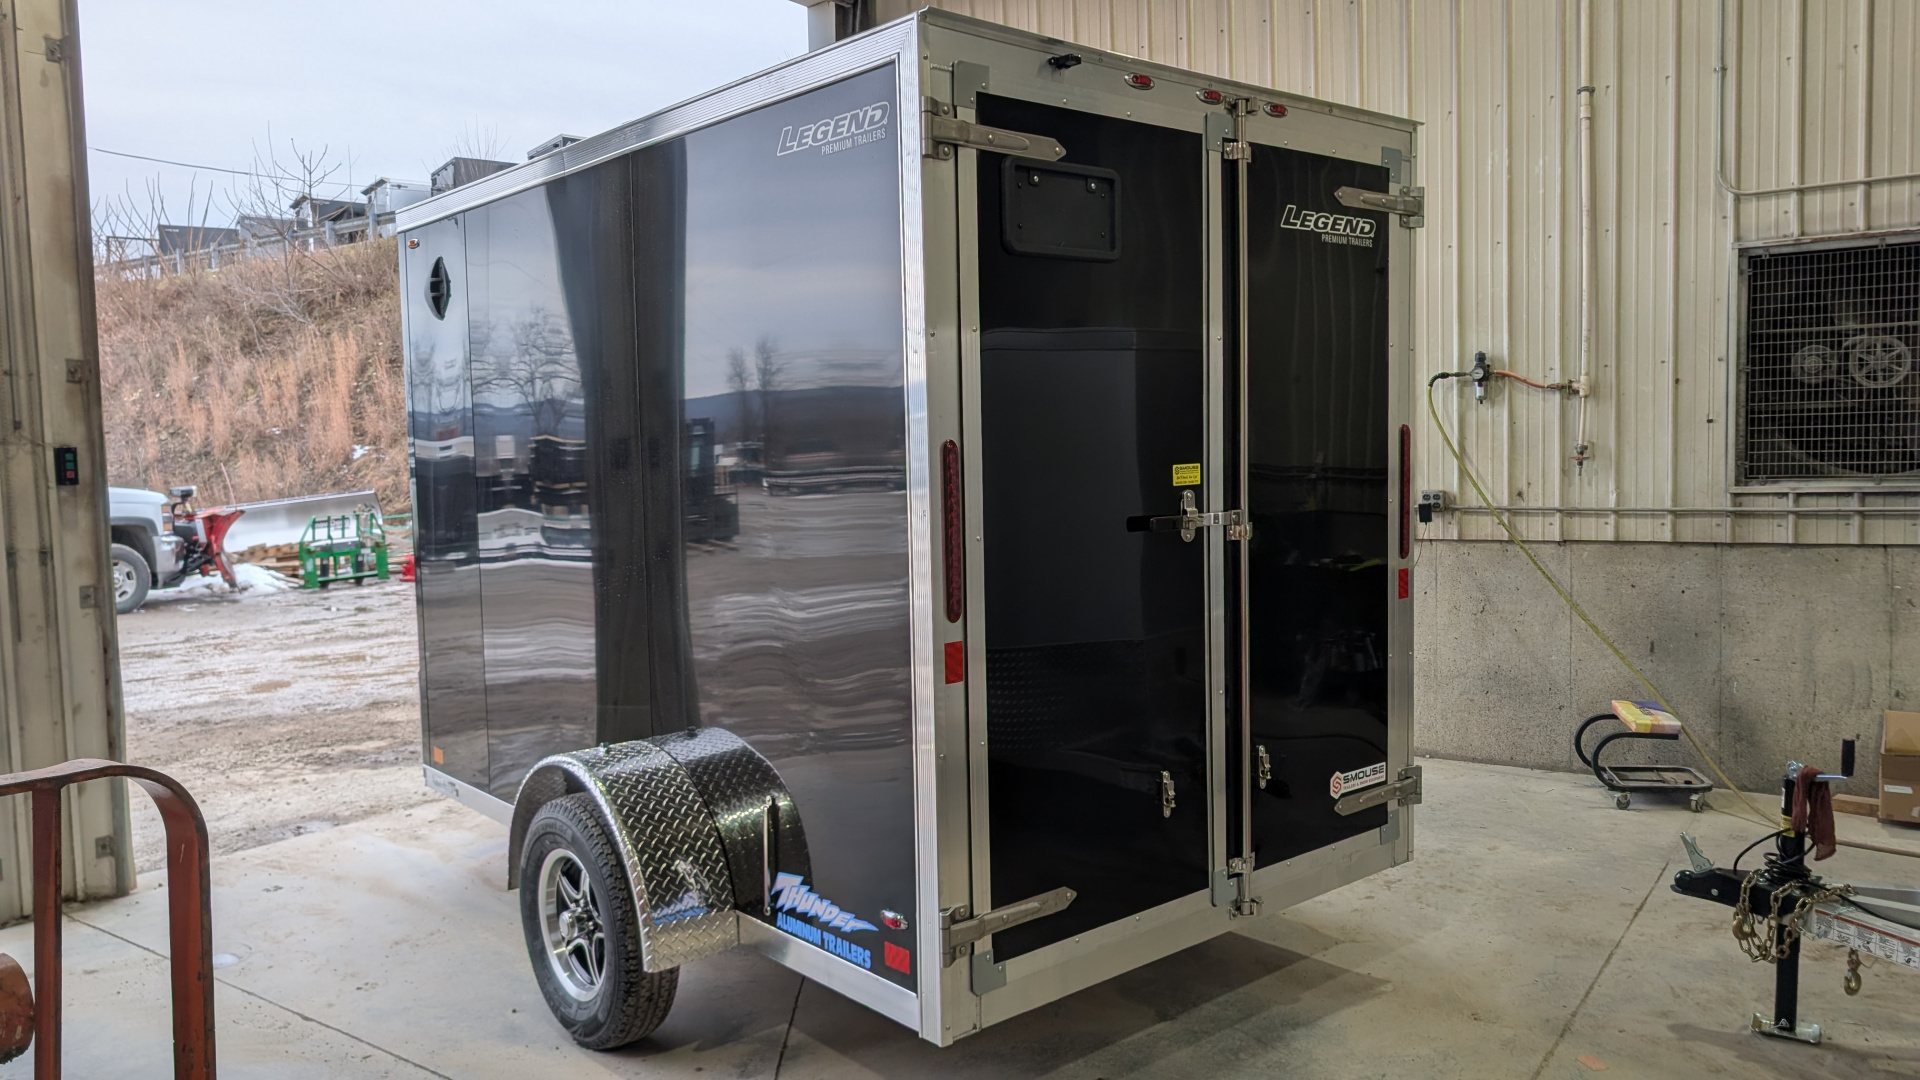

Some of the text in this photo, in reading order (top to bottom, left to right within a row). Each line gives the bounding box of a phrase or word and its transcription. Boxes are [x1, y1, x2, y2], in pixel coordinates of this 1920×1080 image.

[777, 101, 890, 156] LEGEND
[821, 128, 886, 156] PREMIUM TRAILERS
[1280, 204, 1377, 237] LEGEND
[1321, 233, 1373, 248] PREMIUM TRAILERS
[1343, 764, 1385, 784] SMOUSE
[776, 912, 871, 970] ALUMINUM TRAILERS
